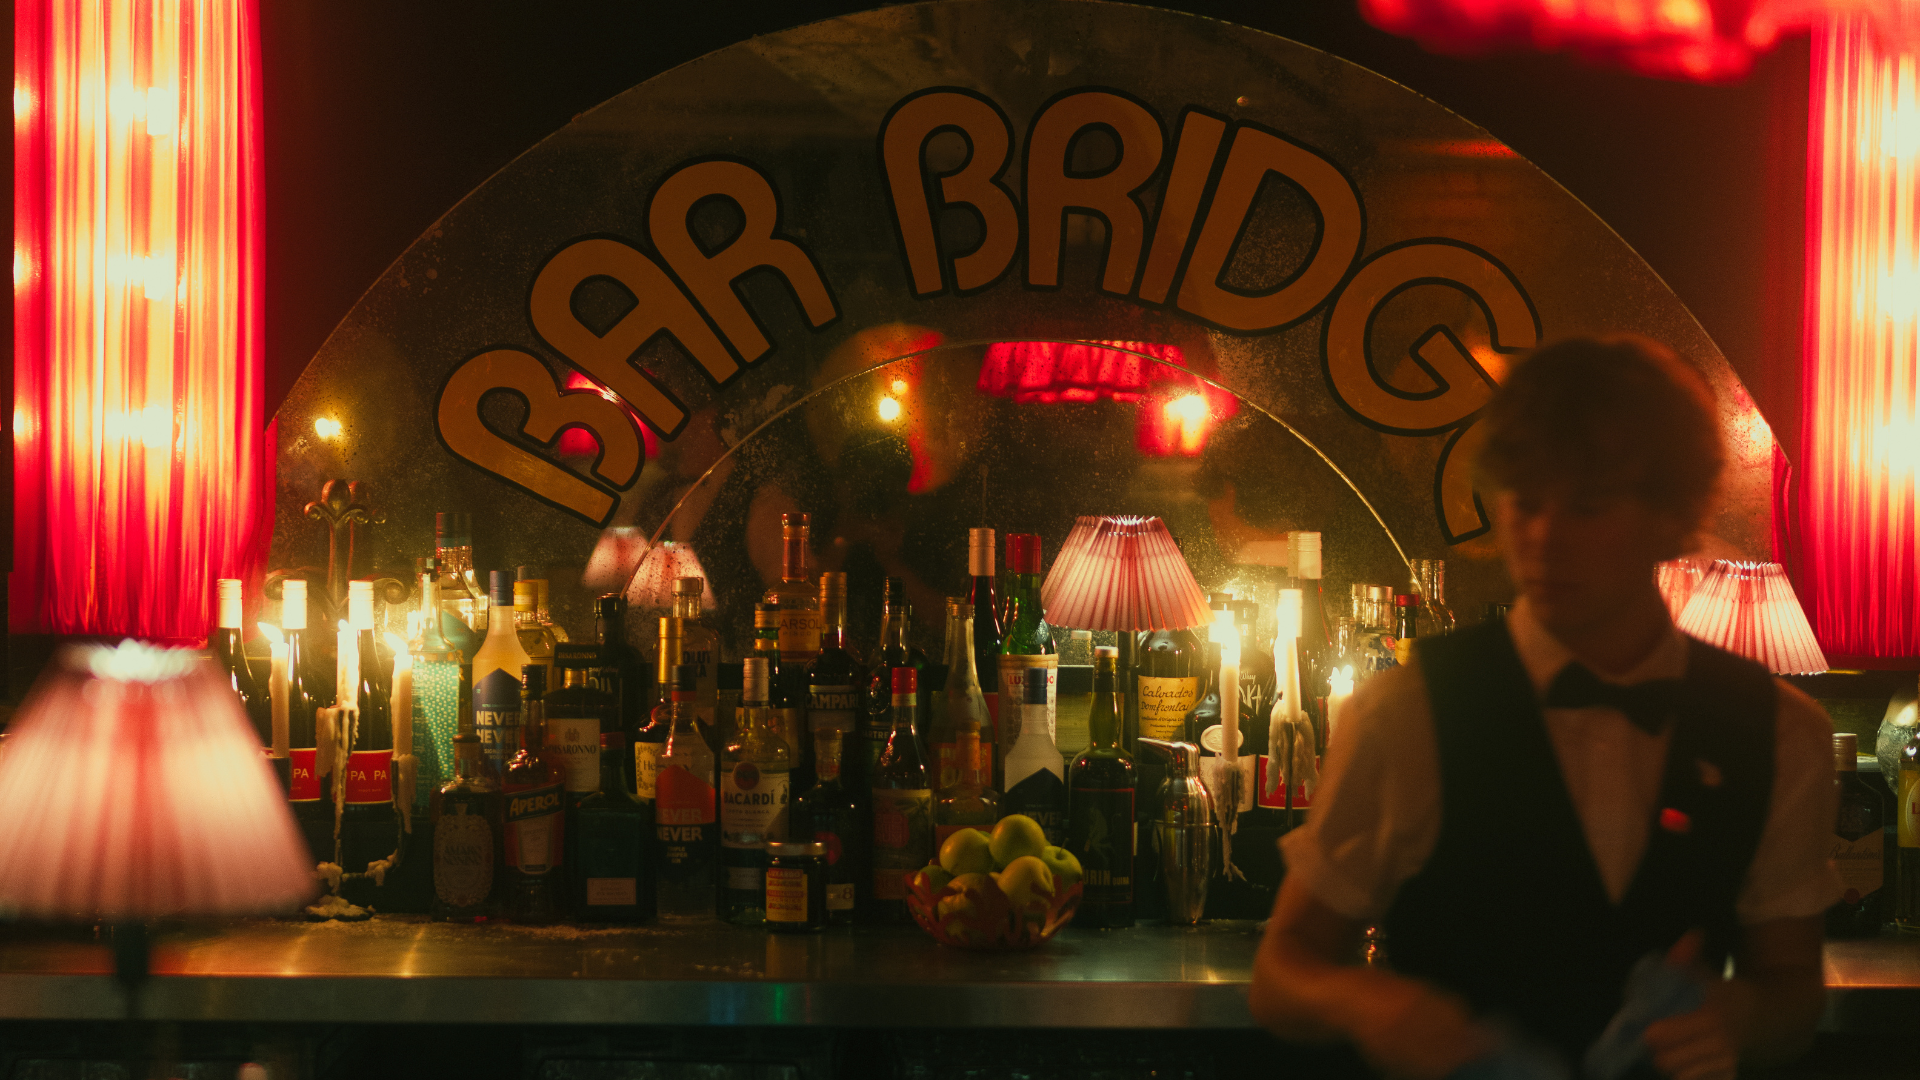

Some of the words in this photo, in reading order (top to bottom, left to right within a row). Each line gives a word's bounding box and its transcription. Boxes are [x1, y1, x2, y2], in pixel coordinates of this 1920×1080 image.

[434, 154, 842, 528] BAR
[780, 618, 822, 630] ARSOL
[1142, 685, 1194, 698] Calvados
[804, 693, 860, 710] CAMPARI
[292, 767, 310, 779] PA
[350, 770, 367, 781] PA
[373, 769, 388, 781] PA
[723, 789, 775, 805] BACARDÍ
[509, 792, 561, 817] APEROL
